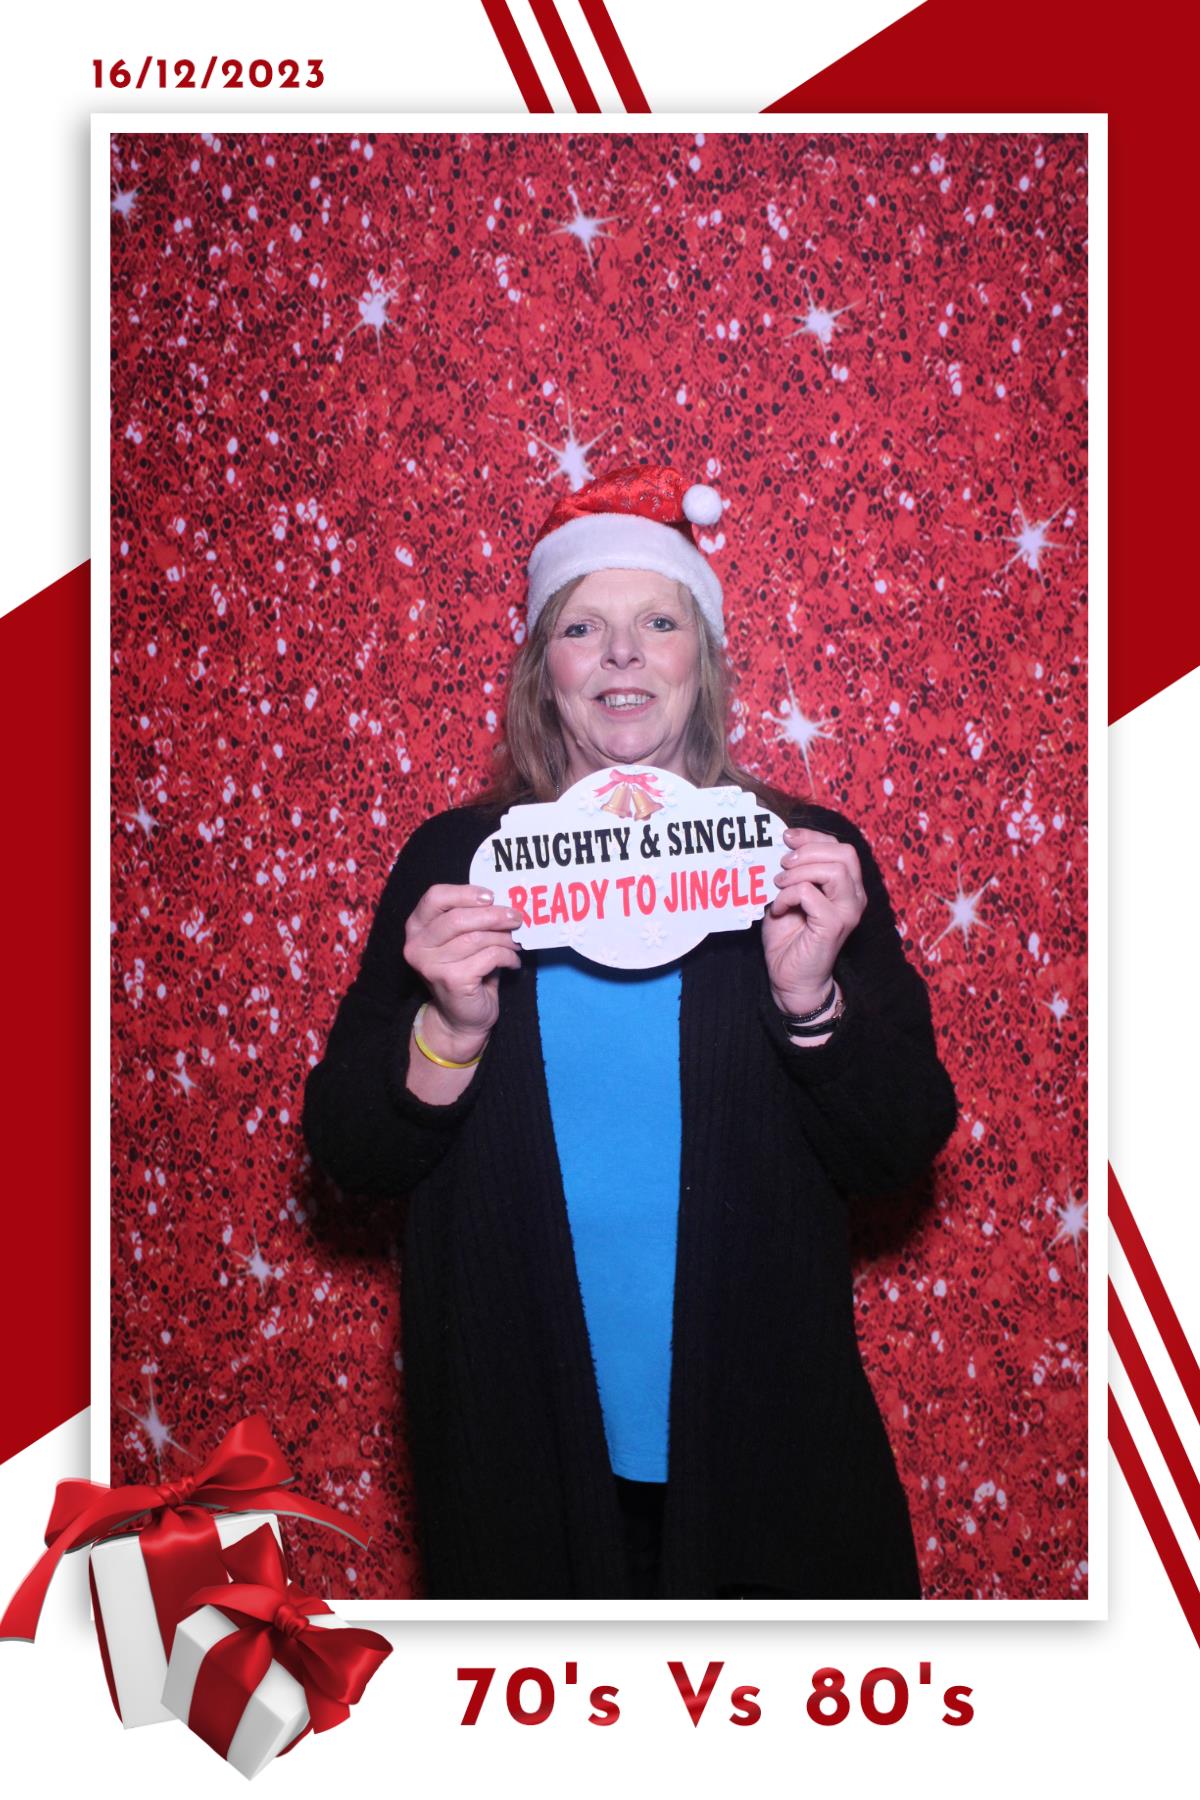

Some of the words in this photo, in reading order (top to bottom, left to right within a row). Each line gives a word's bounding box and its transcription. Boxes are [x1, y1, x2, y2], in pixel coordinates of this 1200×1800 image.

[491, 827, 631, 872] NAUGHTY
[640, 824, 661, 859] &
[667, 813, 772, 855] SINGLE
[508, 878, 609, 928] READY
[616, 875, 656, 917] TO
[663, 865, 767, 912] JINGLE
